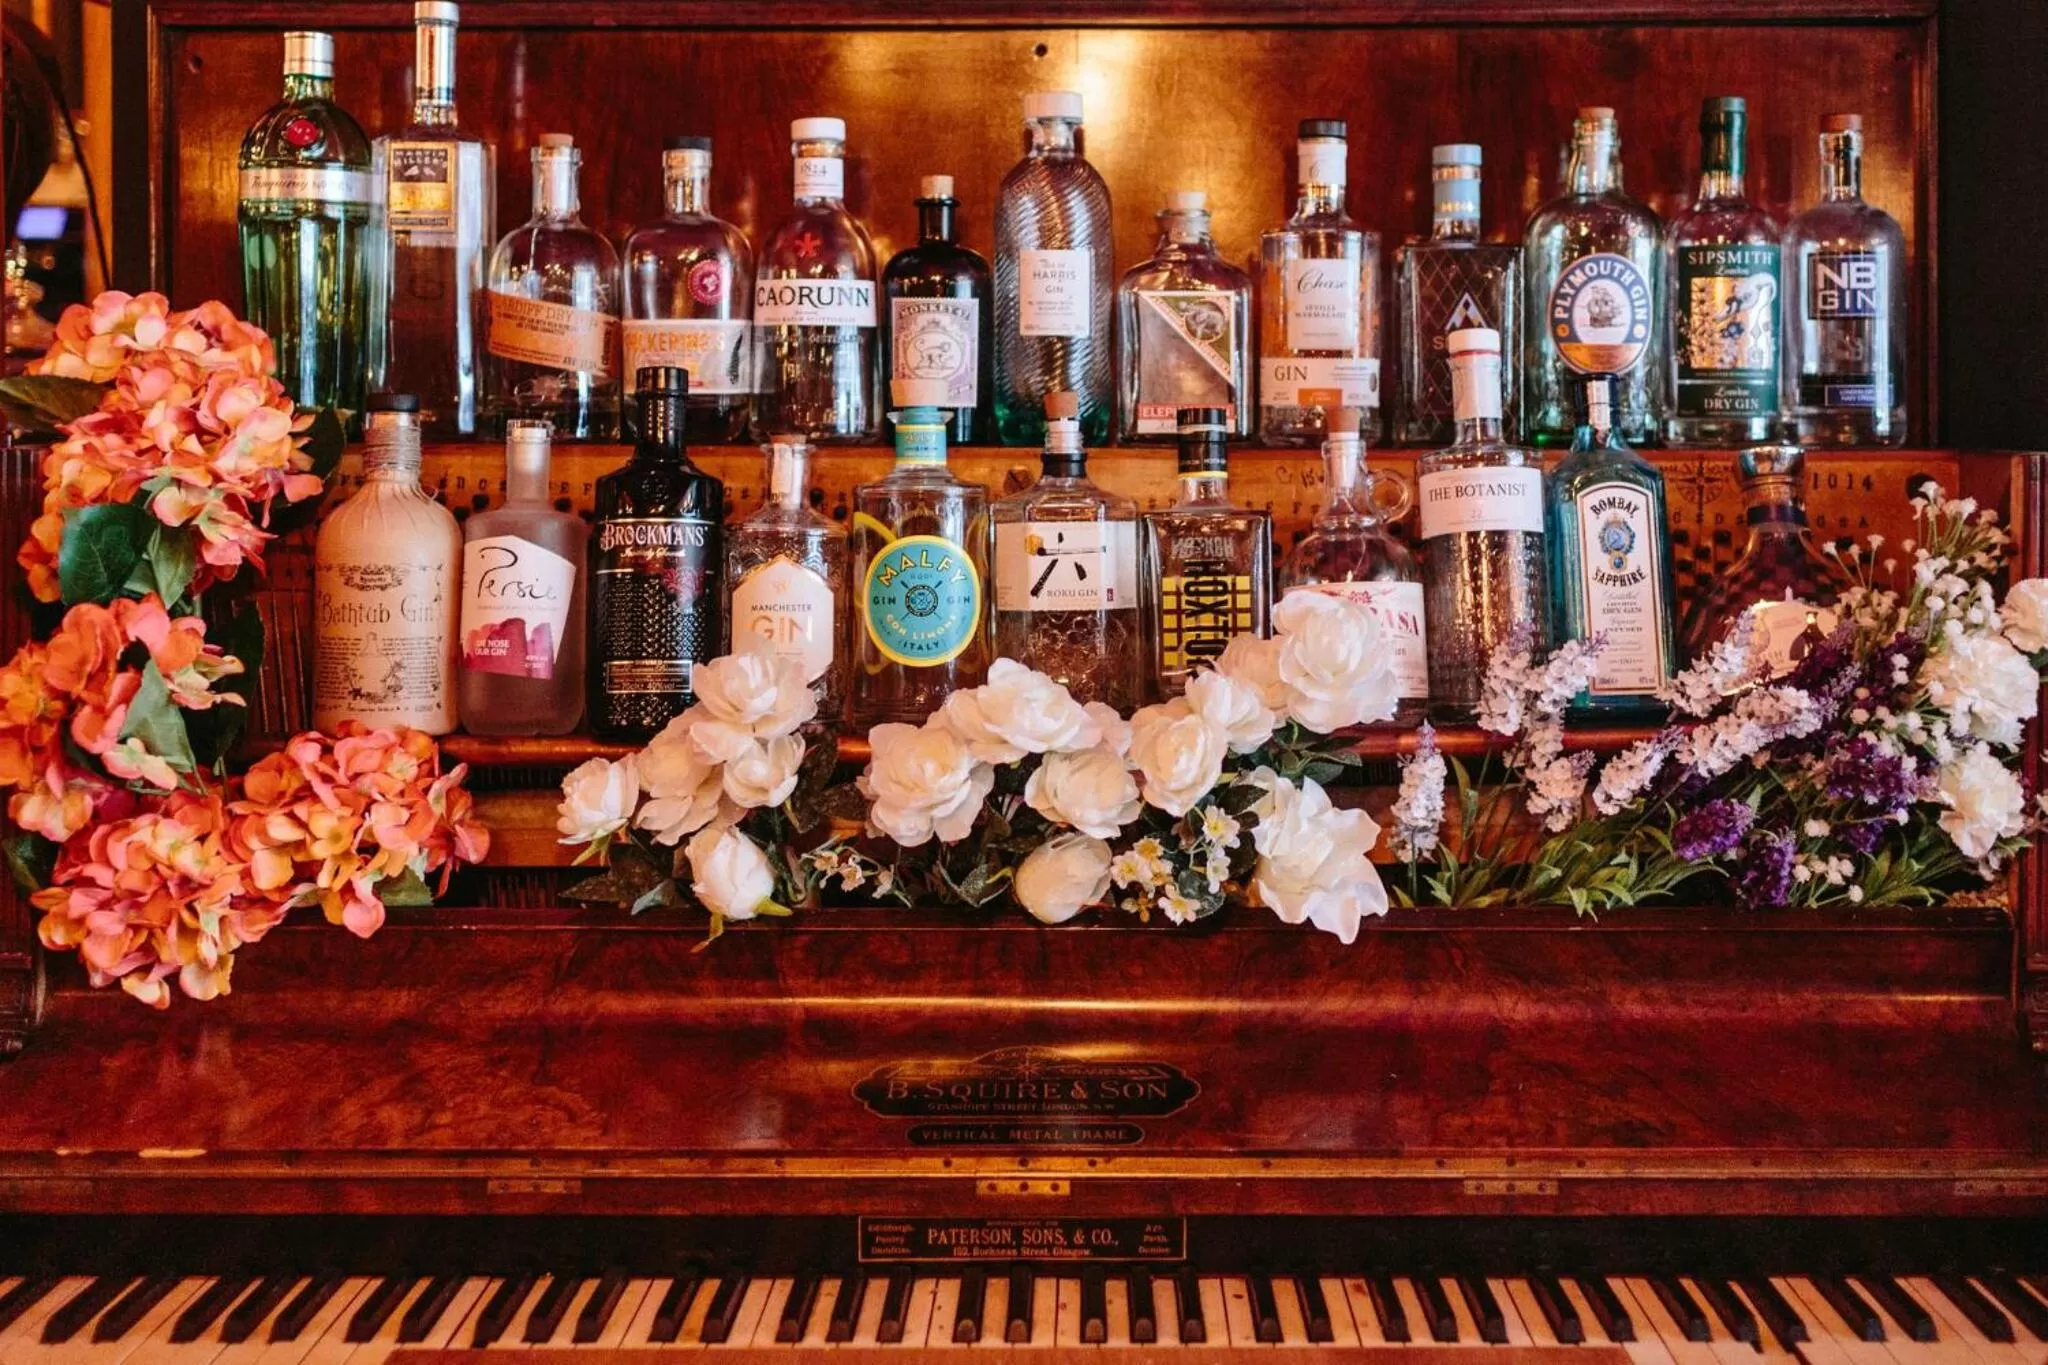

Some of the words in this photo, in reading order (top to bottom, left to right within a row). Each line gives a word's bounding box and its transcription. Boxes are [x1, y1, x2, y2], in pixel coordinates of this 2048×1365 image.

[1687, 251, 1773, 265] SIPSMITH
[1032, 269, 1077, 281] HARRIS
[1817, 261, 1877, 289] NB
[756, 285, 871, 309] CAORUNN
[1045, 285, 1064, 294] GIN
[1554, 260, 1636, 319] PLYMOUTH
[1630, 284, 1648, 320] GIN
[1818, 289, 1877, 310] GIN
[1275, 364, 1309, 382] GIN
[1704, 398, 1733, 411] DRY
[1735, 398, 1760, 411] GIN
[1811, 471, 1875, 491] 1014
[1429, 489, 1451, 502] THE
[1455, 484, 1528, 499] BOTANIST
[1590, 497, 1640, 519] BOMBAY
[600, 515, 705, 552] BROCKMANS
[878, 549, 967, 587] MALFY
[1592, 564, 1647, 588] SAPPHIRE
[872, 595, 897, 606] GIN
[946, 595, 971, 605] GIN
[1047, 589, 1077, 598] ROKU
[1078, 589, 1098, 598] GIN
[321, 591, 391, 627] Bathtub
[750, 603, 813, 613] MANCHESTER
[751, 615, 813, 643] GIN
[902, 640, 940, 651] ITALY
[887, 1080, 917, 1100] B.
[924, 1080, 1062, 1102] SQUIRE
[1070, 1080, 1089, 1100] &
[1100, 1080, 1169, 1100] SON
[922, 1129, 996, 1141] VERTICAL
[1008, 1129, 1064, 1141] METAL
[1072, 1129, 1129, 1141] FRAME
[928, 1228, 1017, 1246] PATERSON,
[1022, 1228, 1068, 1245] SONS,
[1073, 1228, 1085, 1245] &
